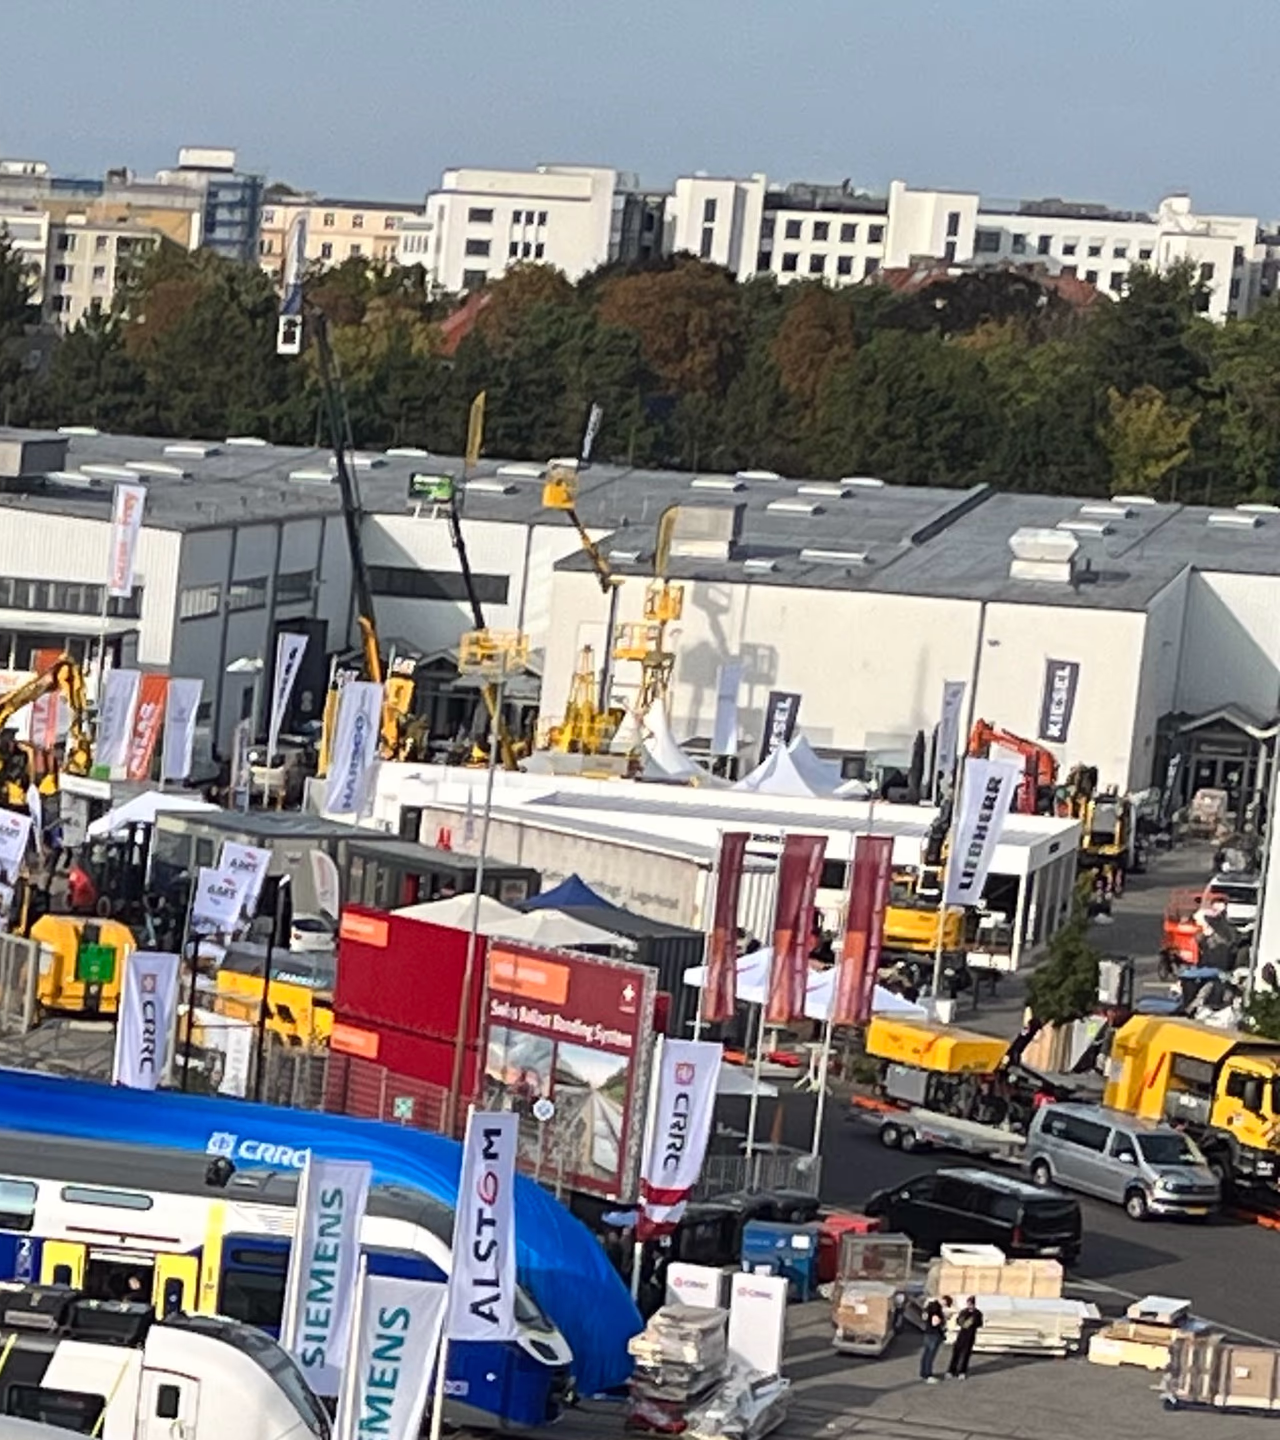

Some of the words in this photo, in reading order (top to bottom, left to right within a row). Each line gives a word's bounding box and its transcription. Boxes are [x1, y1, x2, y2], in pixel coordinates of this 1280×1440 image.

[1046, 665, 1071, 738] KIESEL
[958, 775, 1003, 891] LIEBHERR
[139, 999, 157, 1074] CRRC
[662, 1091, 690, 1173] CRRC
[20, 1239, 31, 1256] 2
[468, 1126, 503, 1326] ALSTOM
[300, 1185, 345, 1370] SIEMENS
